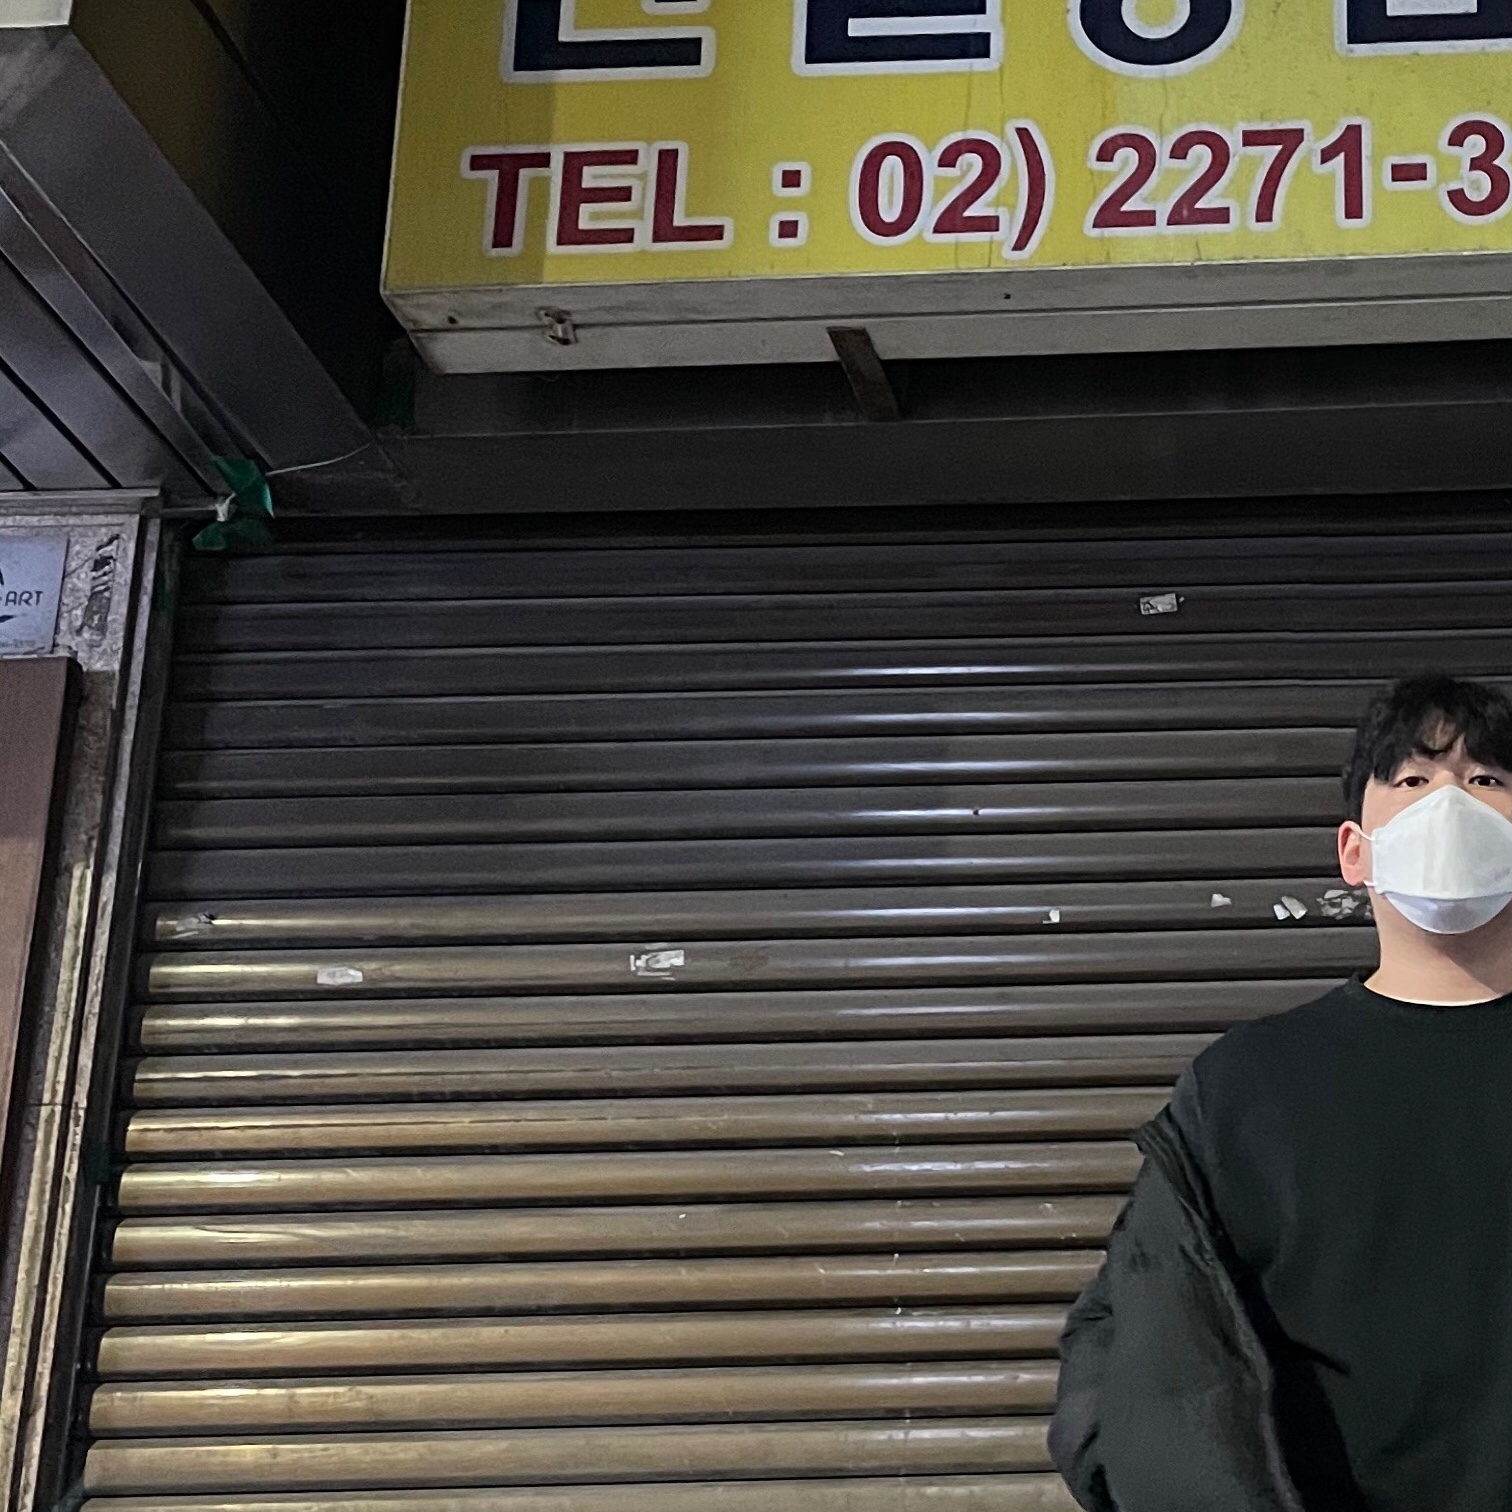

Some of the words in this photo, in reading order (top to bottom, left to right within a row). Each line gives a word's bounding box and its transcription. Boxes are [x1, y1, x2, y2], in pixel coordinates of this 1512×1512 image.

[469, 147, 725, 249] TEL
[857, 126, 1046, 252] 02)
[0, 590, 43, 606] ART
